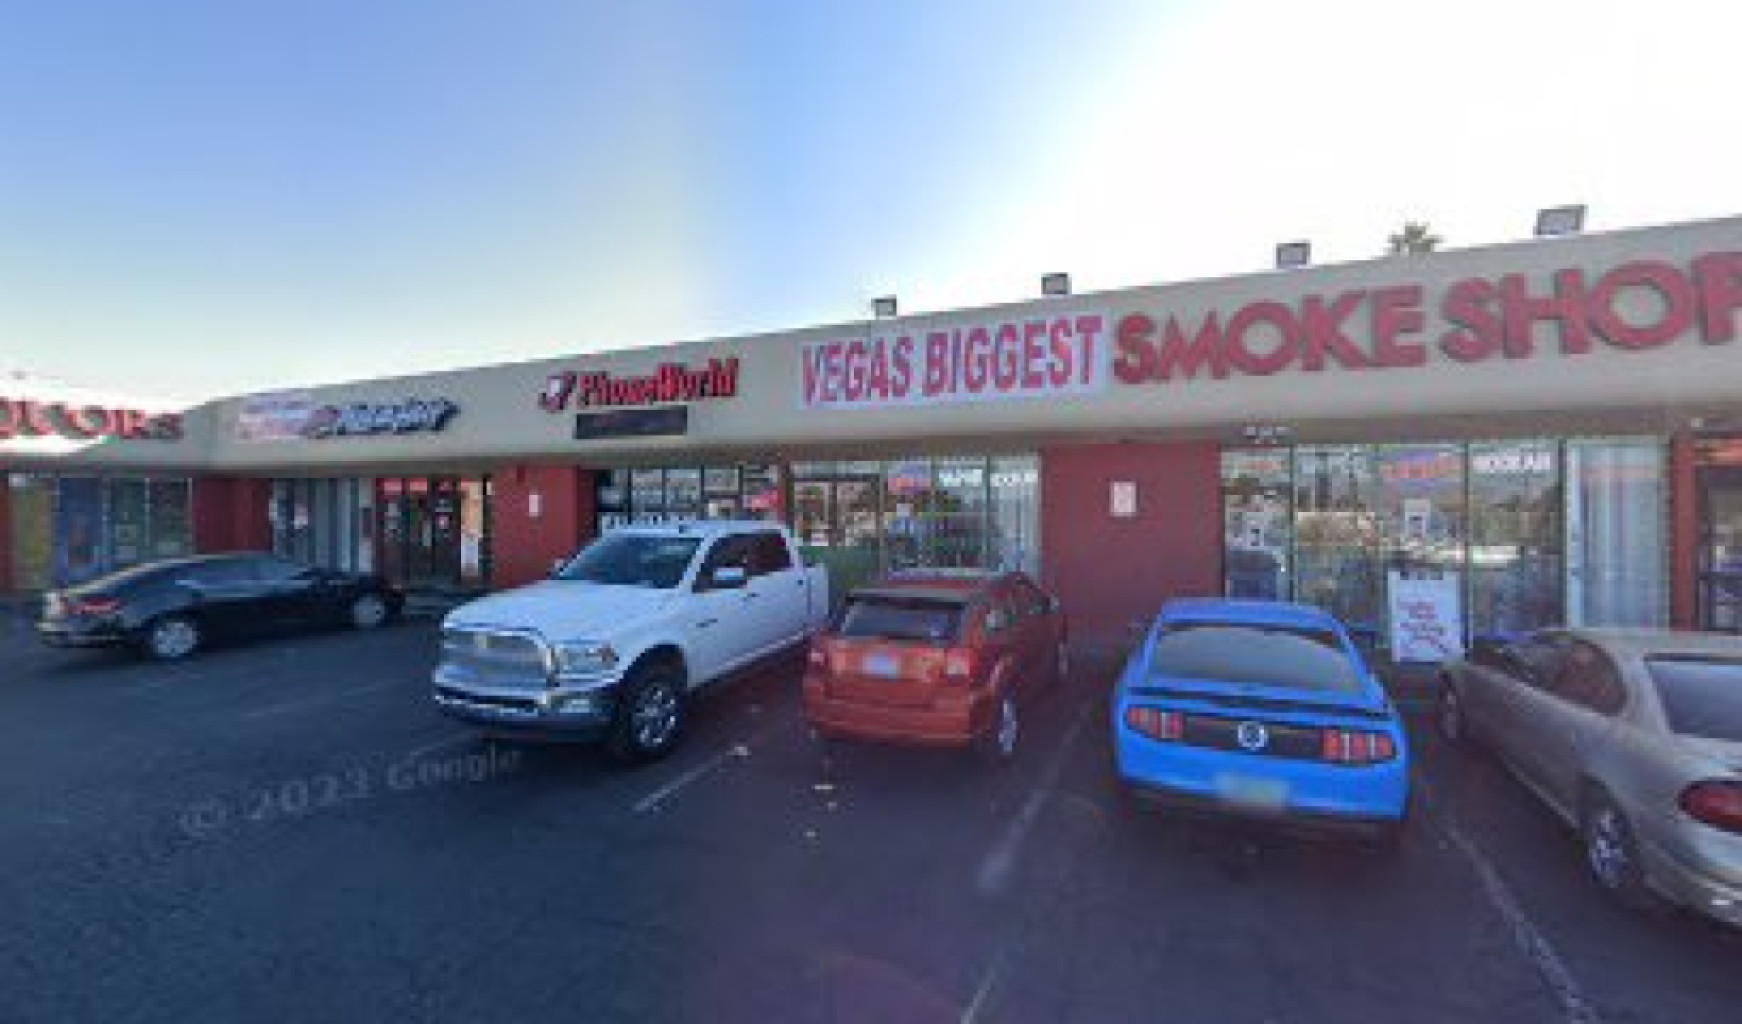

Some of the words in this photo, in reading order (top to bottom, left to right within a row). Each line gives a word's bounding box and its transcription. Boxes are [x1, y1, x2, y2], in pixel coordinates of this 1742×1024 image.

[802, 336, 914, 406] VEGAS
[922, 315, 1103, 398] BIGGEST
[1113, 285, 1426, 385] SMOKE
[1440, 251, 1742, 363] SHOP
